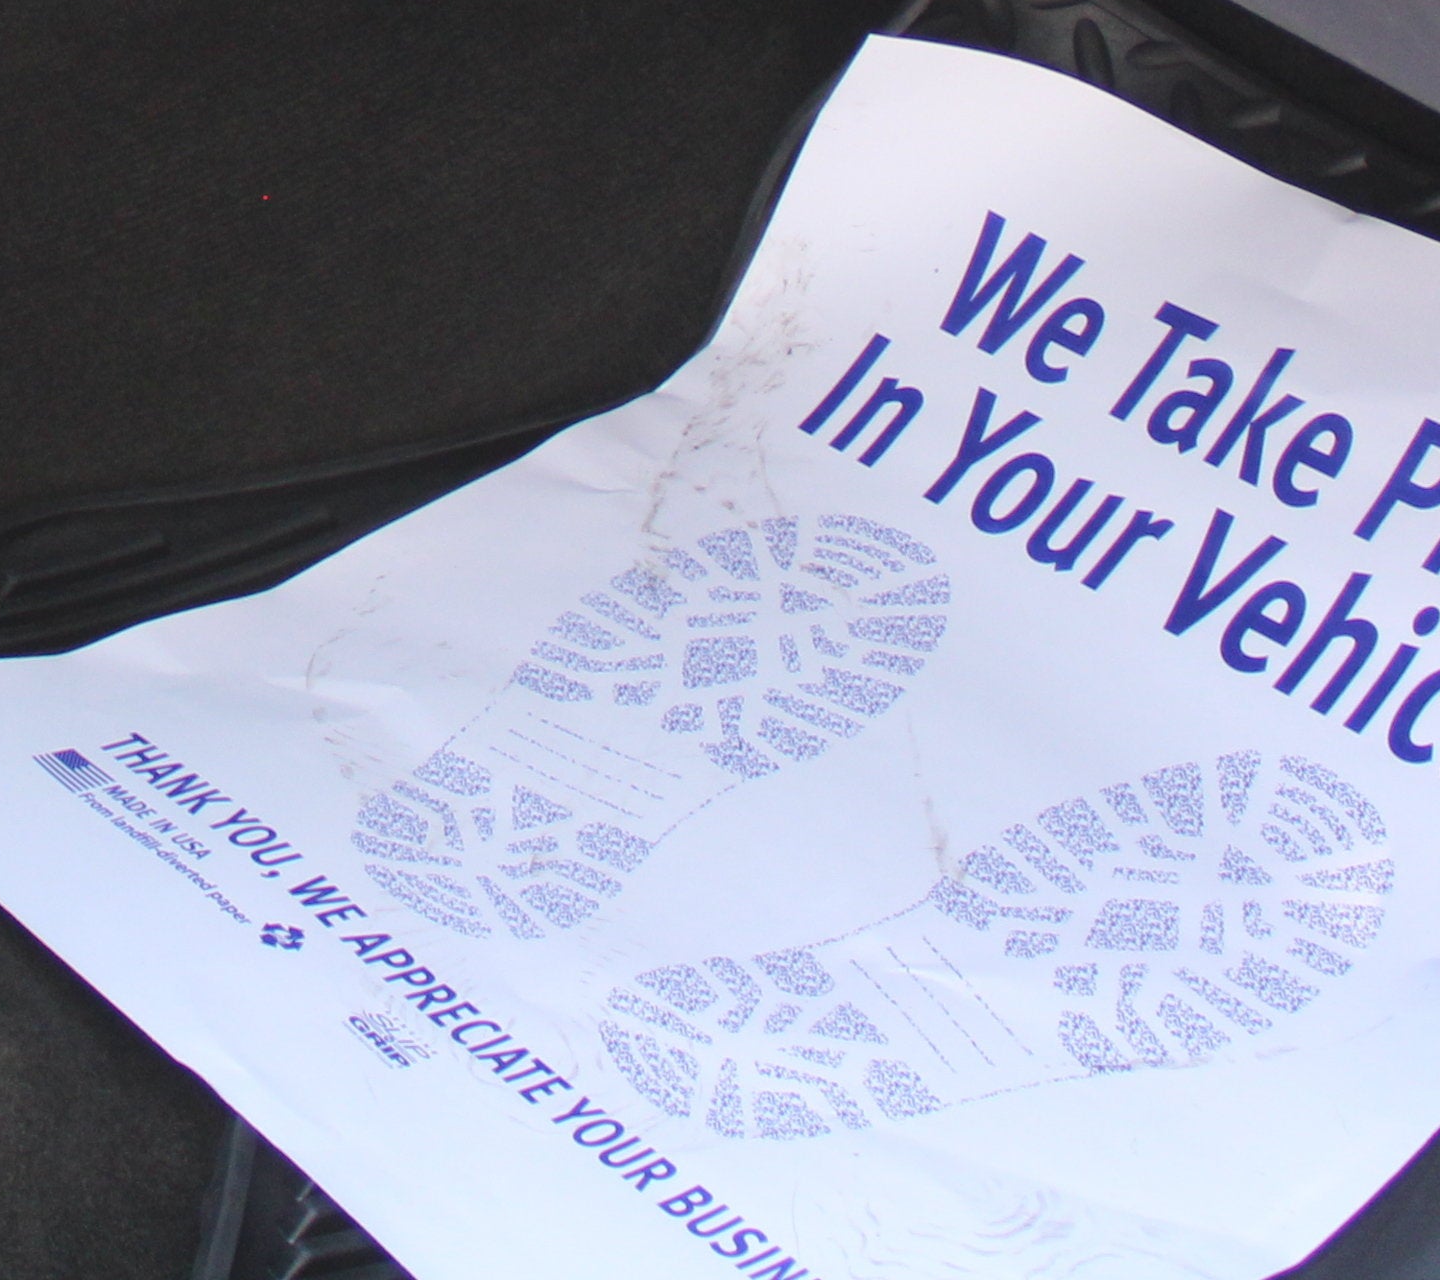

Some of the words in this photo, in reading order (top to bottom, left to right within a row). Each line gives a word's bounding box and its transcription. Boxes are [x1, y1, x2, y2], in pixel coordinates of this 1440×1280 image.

[940, 210, 1107, 383] We
[1109, 302, 1354, 508] Take
[799, 333, 924, 467] In
[923, 386, 1173, 591] Your
[77, 791, 114, 819] From
[205, 890, 252, 926] paper
[102, 784, 158, 820] MADE
[148, 817, 179, 835] IN
[171, 832, 212, 860] USA
[100, 731, 232, 815] THANK
[209, 807, 304, 878] YOU,
[288, 874, 368, 928] WE
[339, 932, 575, 1105] APPRECIATE
[551, 1095, 677, 1192] YOUR
[656, 1183, 823, 1280] BUSIN
[348, 1016, 411, 1068] GRIP
